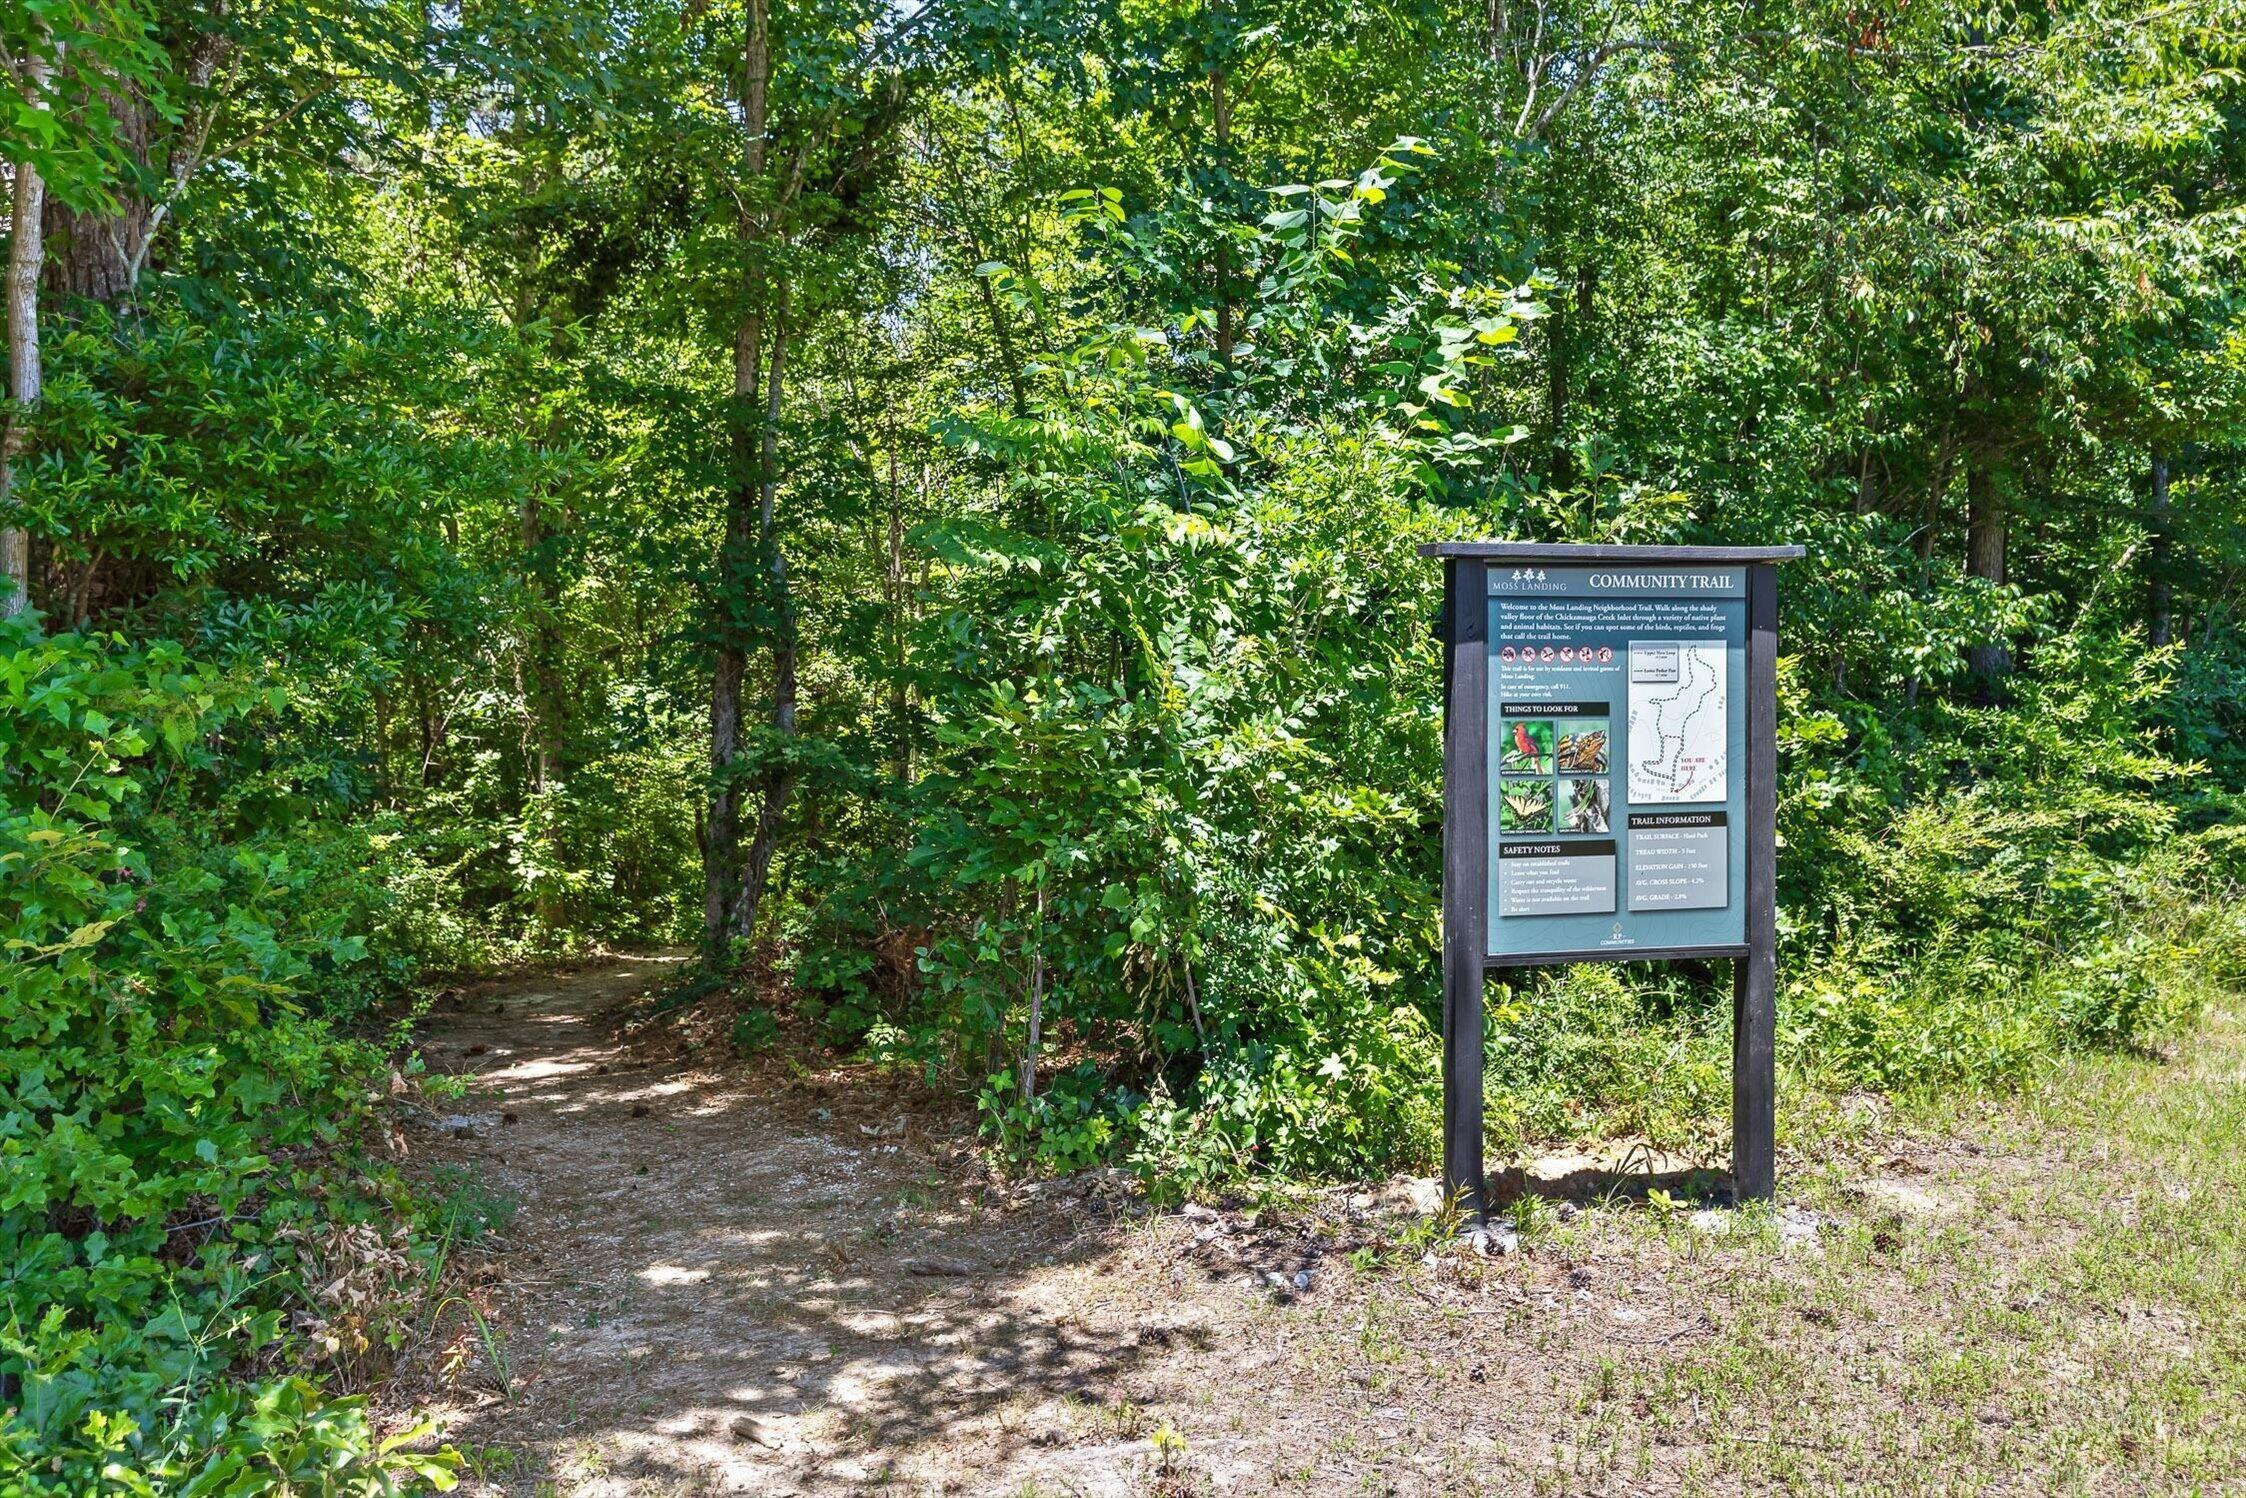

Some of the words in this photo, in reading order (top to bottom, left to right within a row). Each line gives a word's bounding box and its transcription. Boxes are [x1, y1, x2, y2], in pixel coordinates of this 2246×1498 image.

[1492, 582, 1519, 590] MOSS
[1521, 582, 1567, 590] LANDING
[1589, 574, 1687, 589] COMMUNITY
[1689, 574, 1735, 589] TRAIL
[1500, 603, 1528, 611] Welcome
[1538, 603, 1549, 611] the
[1549, 603, 1565, 611] Moss
[1566, 604, 1592, 613] Landing
[1593, 604, 1637, 613] Neighborhood
[1638, 603, 1654, 611] Trail.
[1655, 603, 1671, 611] Walk
[1672, 604, 1688, 614] along
[1689, 603, 1699, 611] the
[1699, 604, 1717, 614] shady
[1500, 614, 1518, 622] valley
[1555, 614, 1597, 623] Chickamauga
[1632, 614, 1656, 623] through
[1662, 615, 1682, 623] variety
[1710, 614, 1726, 623] plant
[1605, 624, 1619, 632] spot
[1710, 624, 1726, 632] frogs
[1500, 632, 1513, 640] that
[1514, 632, 1526, 640] call
[1526, 632, 1537, 640] the
[1537, 632, 1551, 640] trail
[1552, 632, 1572, 640] home.
[1504, 705, 1532, 713] THINGS
[1532, 705, 1541, 713] TO
[1541, 705, 1563, 713] LOOK
[1563, 705, 1579, 713] FOR
[1631, 817, 1656, 826] TRAIL
[1656, 815, 1712, 825] INFORMATION
[1503, 846, 1534, 855] SAFETY
[1535, 845, 1561, 854] NOTES
